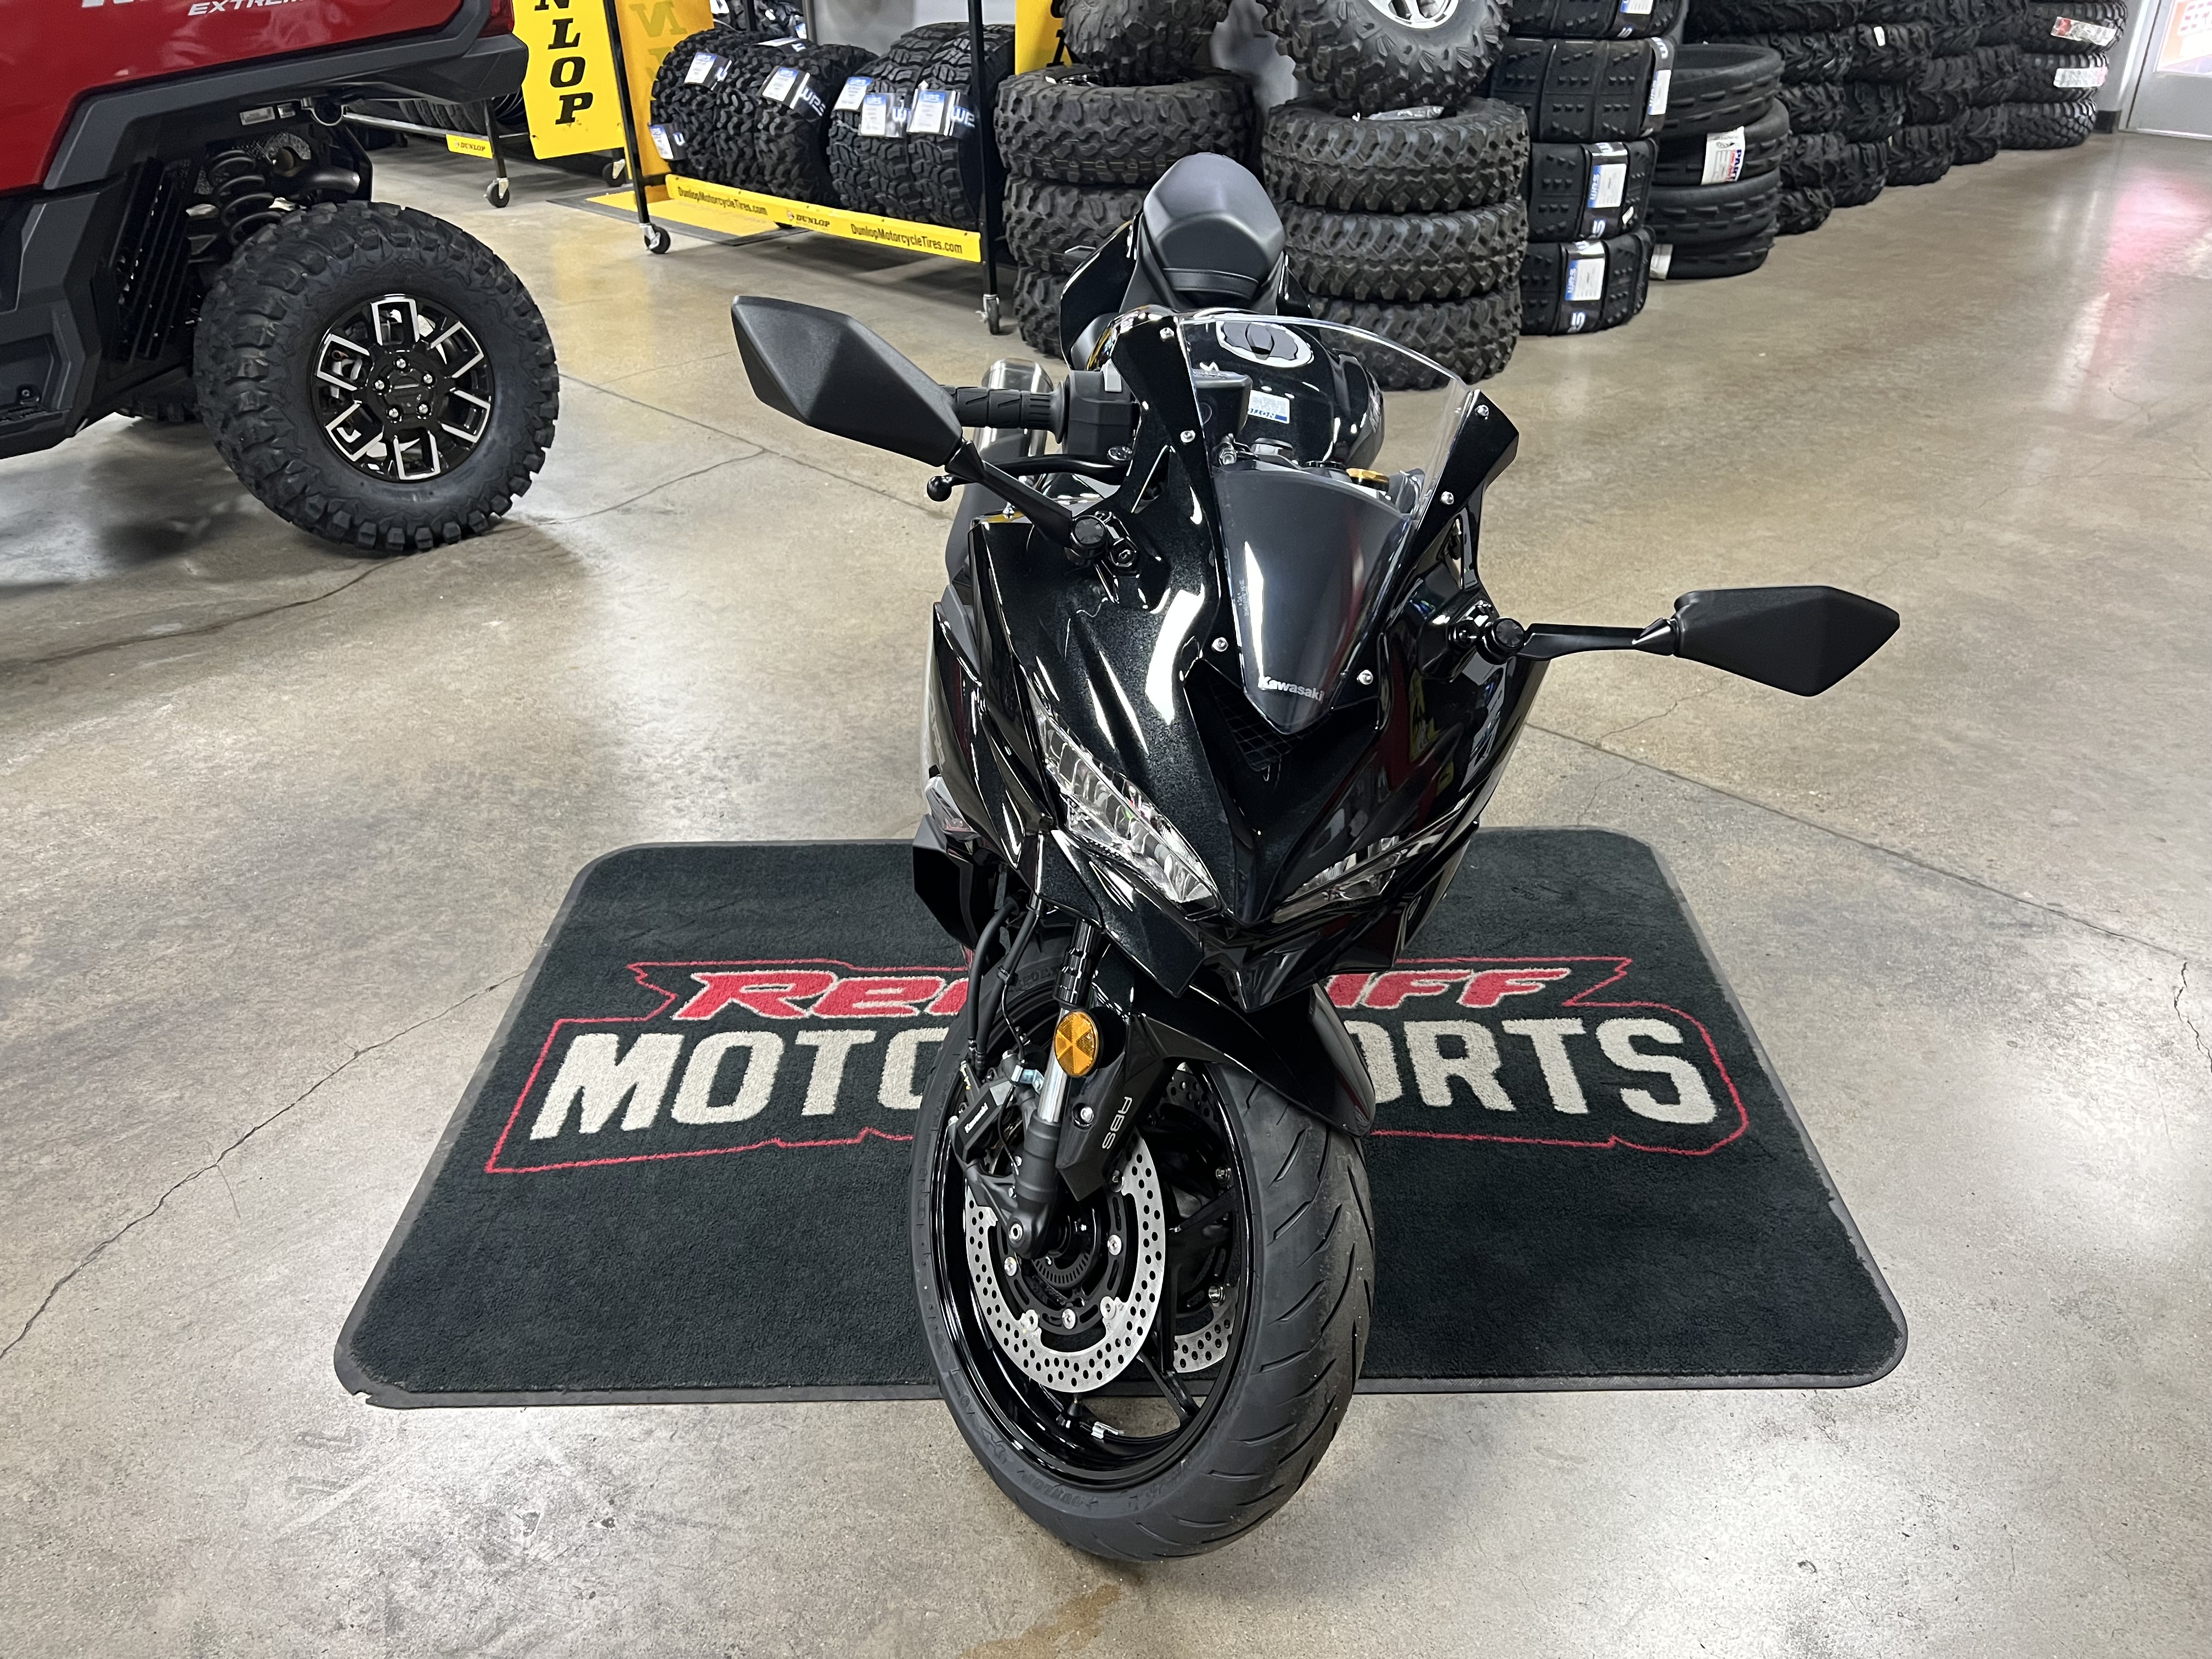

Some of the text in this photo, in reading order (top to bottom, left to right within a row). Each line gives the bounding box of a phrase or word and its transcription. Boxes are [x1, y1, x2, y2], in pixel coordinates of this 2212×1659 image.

[461, 142, 486, 151] DUNLOP
[795, 214, 830, 227] DUNLOP
[850, 223, 963, 254] DunlopMotorcycleTires.com
[1257, 676, 1324, 701] Kawasaki
[964, 1102, 989, 1134] Kawasaki
[1102, 1096, 1133, 1150] ABS
